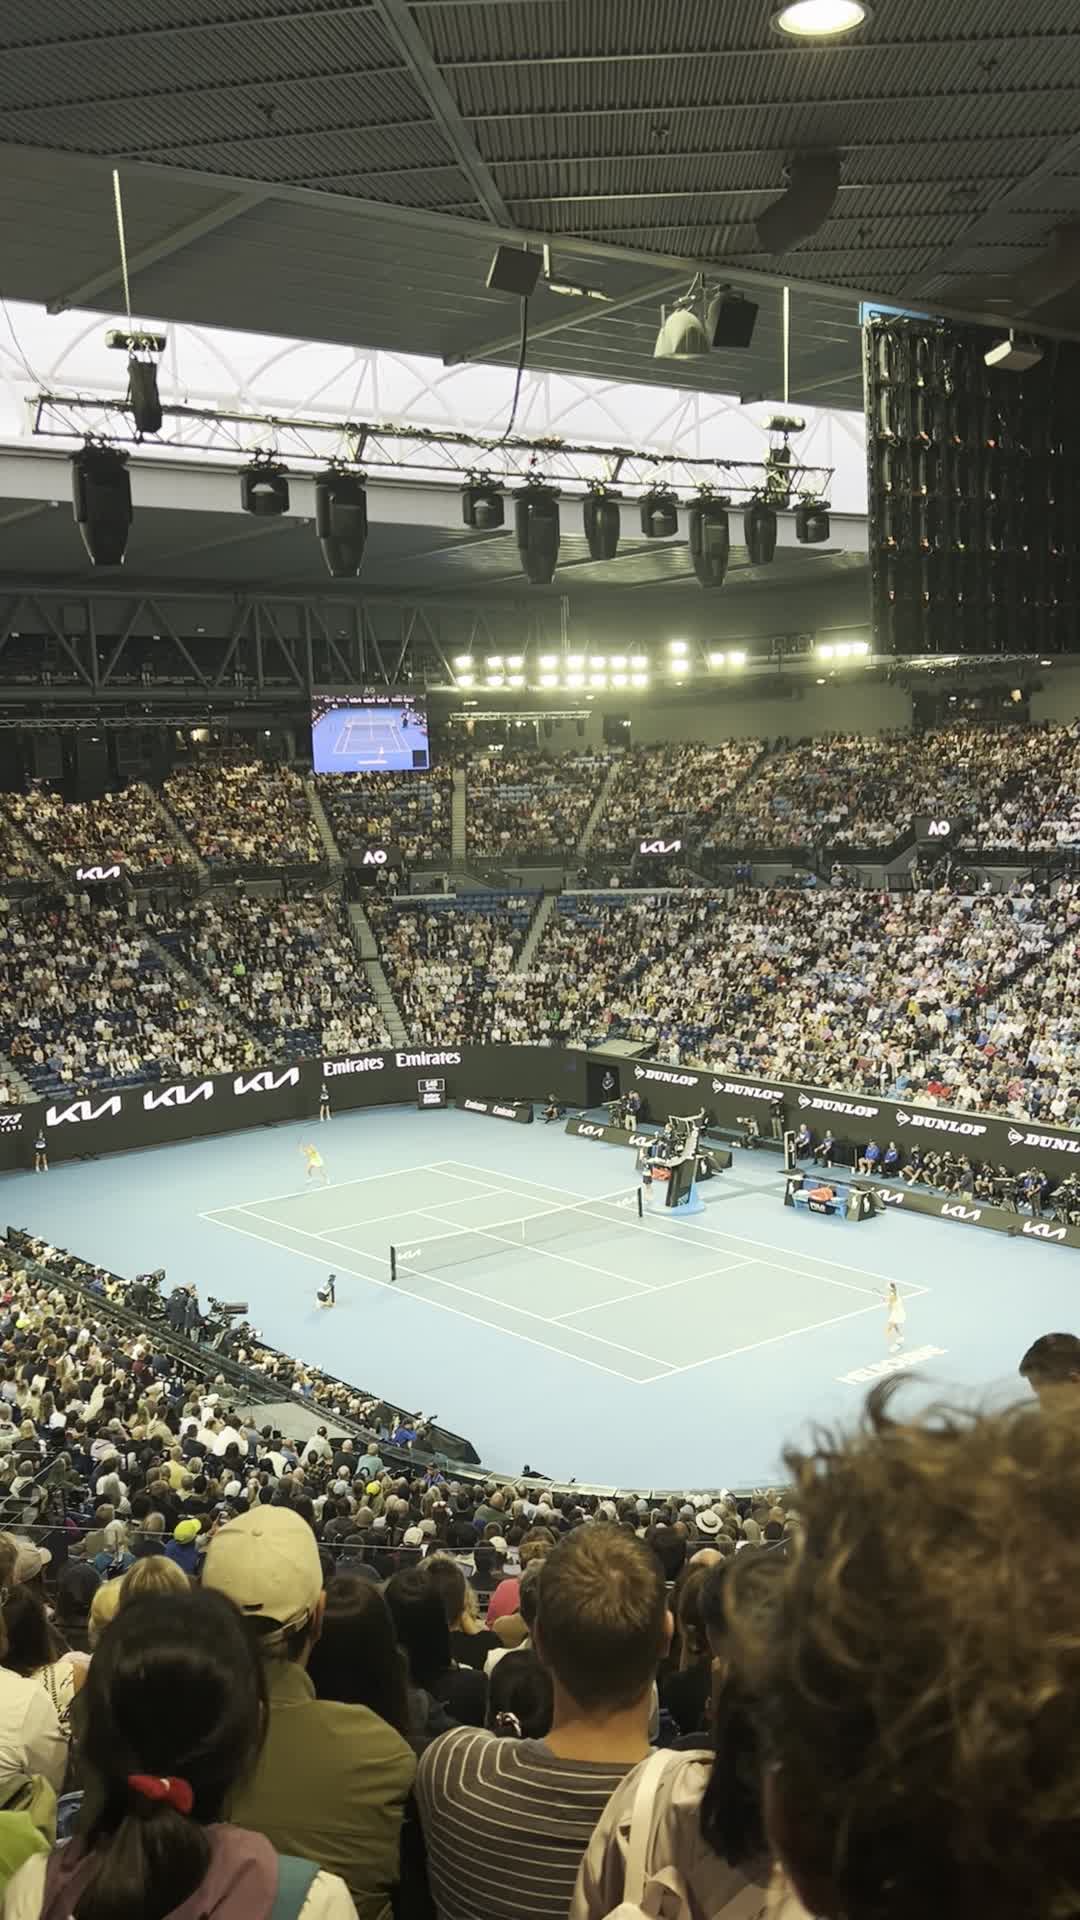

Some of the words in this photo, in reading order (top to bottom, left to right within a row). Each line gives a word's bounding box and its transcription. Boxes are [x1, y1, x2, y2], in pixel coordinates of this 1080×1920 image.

[928, 820, 951, 836] AO
[640, 840, 681, 854] KIA
[362, 850, 388, 864] AO
[76, 866, 121, 881] KIA
[323, 1056, 385, 1077] Emirates
[396, 1051, 461, 1068] Emirates
[232, 1066, 300, 1095] KIA
[644, 1069, 699, 1087] DUNLOP
[143, 1080, 214, 1110] KIA
[723, 1082, 785, 1101] DUNLOP
[46, 1095, 122, 1127] KIA
[810, 1098, 879, 1119] DUNLOP
[910, 1115, 987, 1137] DUNLOP
[941, 1203, 982, 1221] KIA
[1022, 1219, 1067, 1240] KIA
